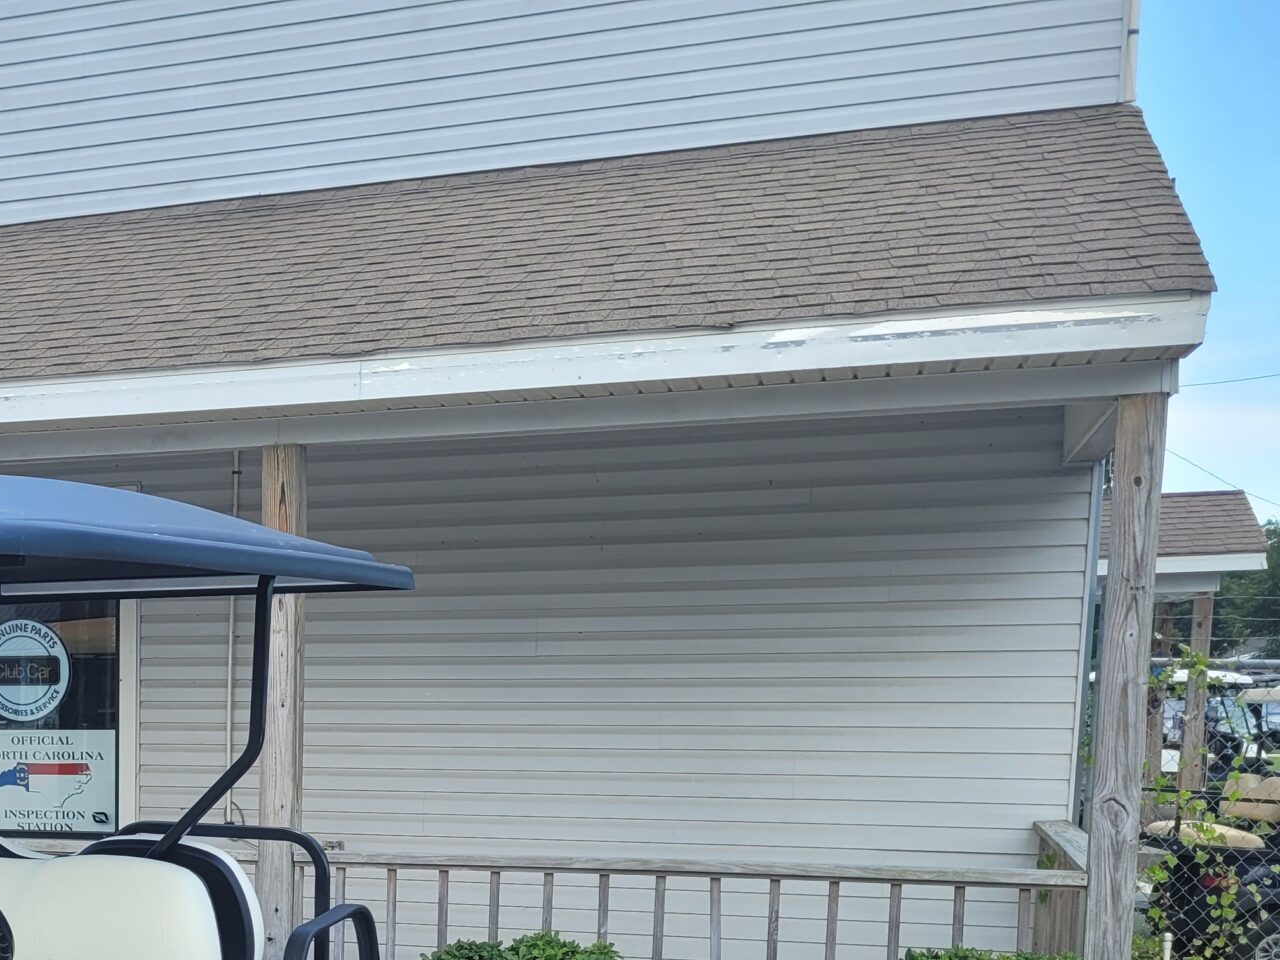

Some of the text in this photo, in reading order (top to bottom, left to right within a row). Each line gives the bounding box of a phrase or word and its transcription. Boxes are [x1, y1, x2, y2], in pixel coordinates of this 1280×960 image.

[30, 624, 58, 649] PARTS
[27, 663, 52, 679] Car
[36, 688, 60, 713] SERVICE
[11, 736, 74, 746] OFFICIAL
[33, 750, 104, 761] CAROLINA
[4, 809, 86, 820] INSPECTION
[17, 822, 73, 832] STATION
